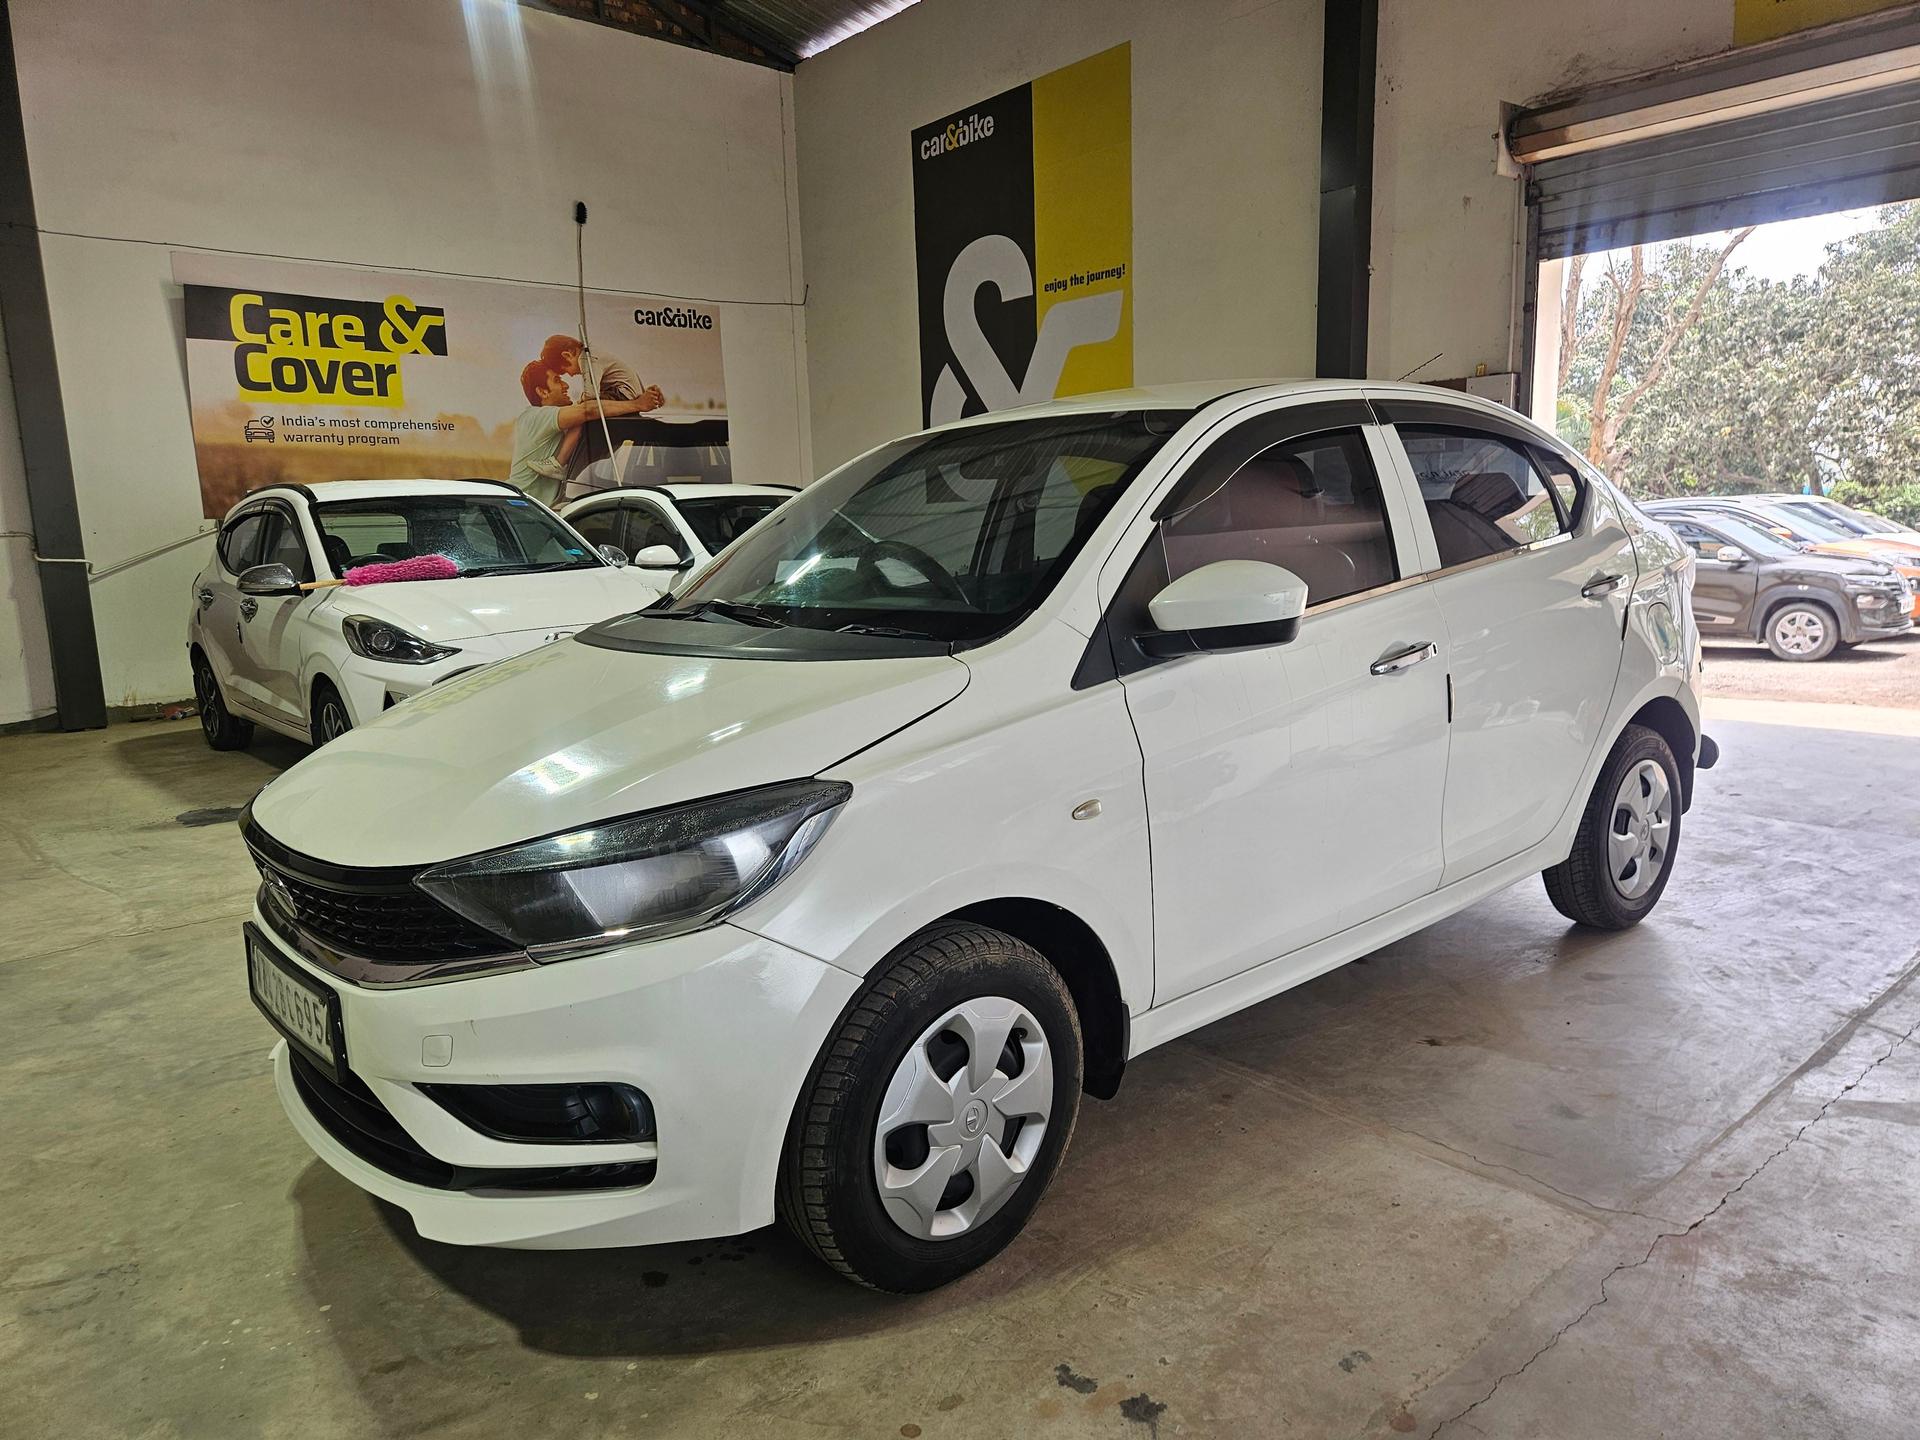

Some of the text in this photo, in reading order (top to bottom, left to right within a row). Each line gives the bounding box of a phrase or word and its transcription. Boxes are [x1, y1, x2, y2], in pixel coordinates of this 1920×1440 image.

[920, 112, 995, 160] car&bike
[1043, 263, 1126, 293] enjoy the journey!
[229, 293, 445, 356] Care &
[634, 306, 712, 330] car&bike
[234, 342, 397, 398] Cover
[281, 415, 455, 432] India’s most comprehensive
[284, 432, 400, 446] warranty program
